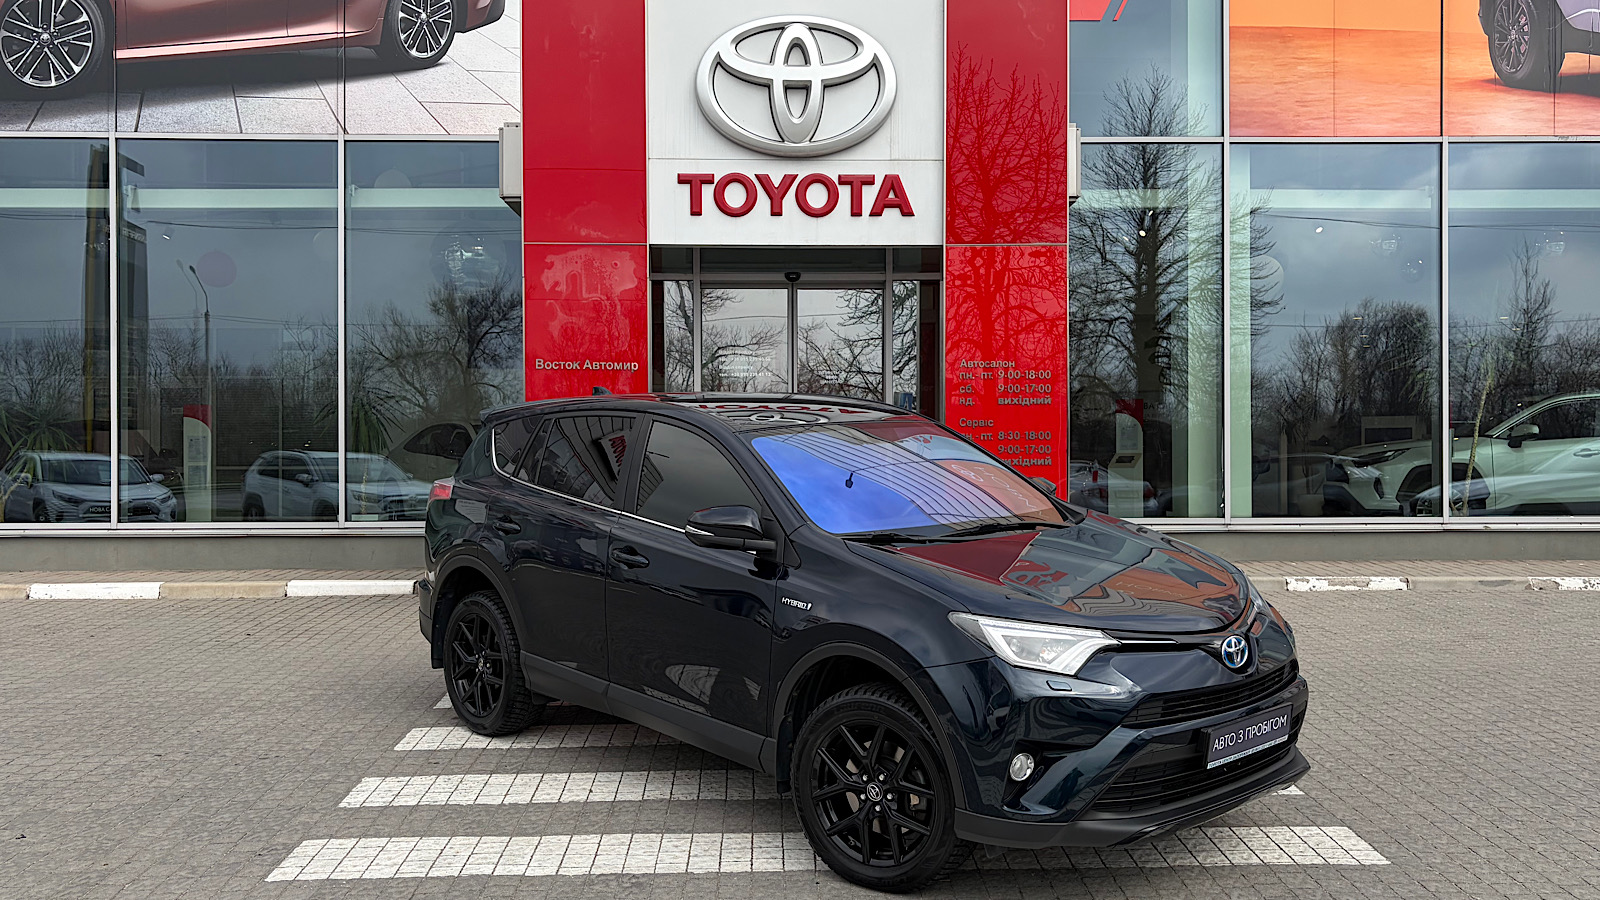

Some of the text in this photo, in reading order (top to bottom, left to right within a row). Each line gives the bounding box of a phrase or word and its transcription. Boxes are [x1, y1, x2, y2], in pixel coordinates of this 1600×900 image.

[677, 172, 915, 218] TOYOTA
[535, 358, 639, 373] Восток Автомир
[959, 359, 1015, 368] Автосалон
[959, 384, 975, 393] сб.
[959, 395, 1051, 406] нд. вихідний
[959, 418, 994, 428] Сервіс
[781, 597, 807, 610] HYBRID
[1212, 733, 1237, 752] АВТО
[1237, 731, 1244, 743] З
[1245, 714, 1288, 741] ПРОБІГОМ
